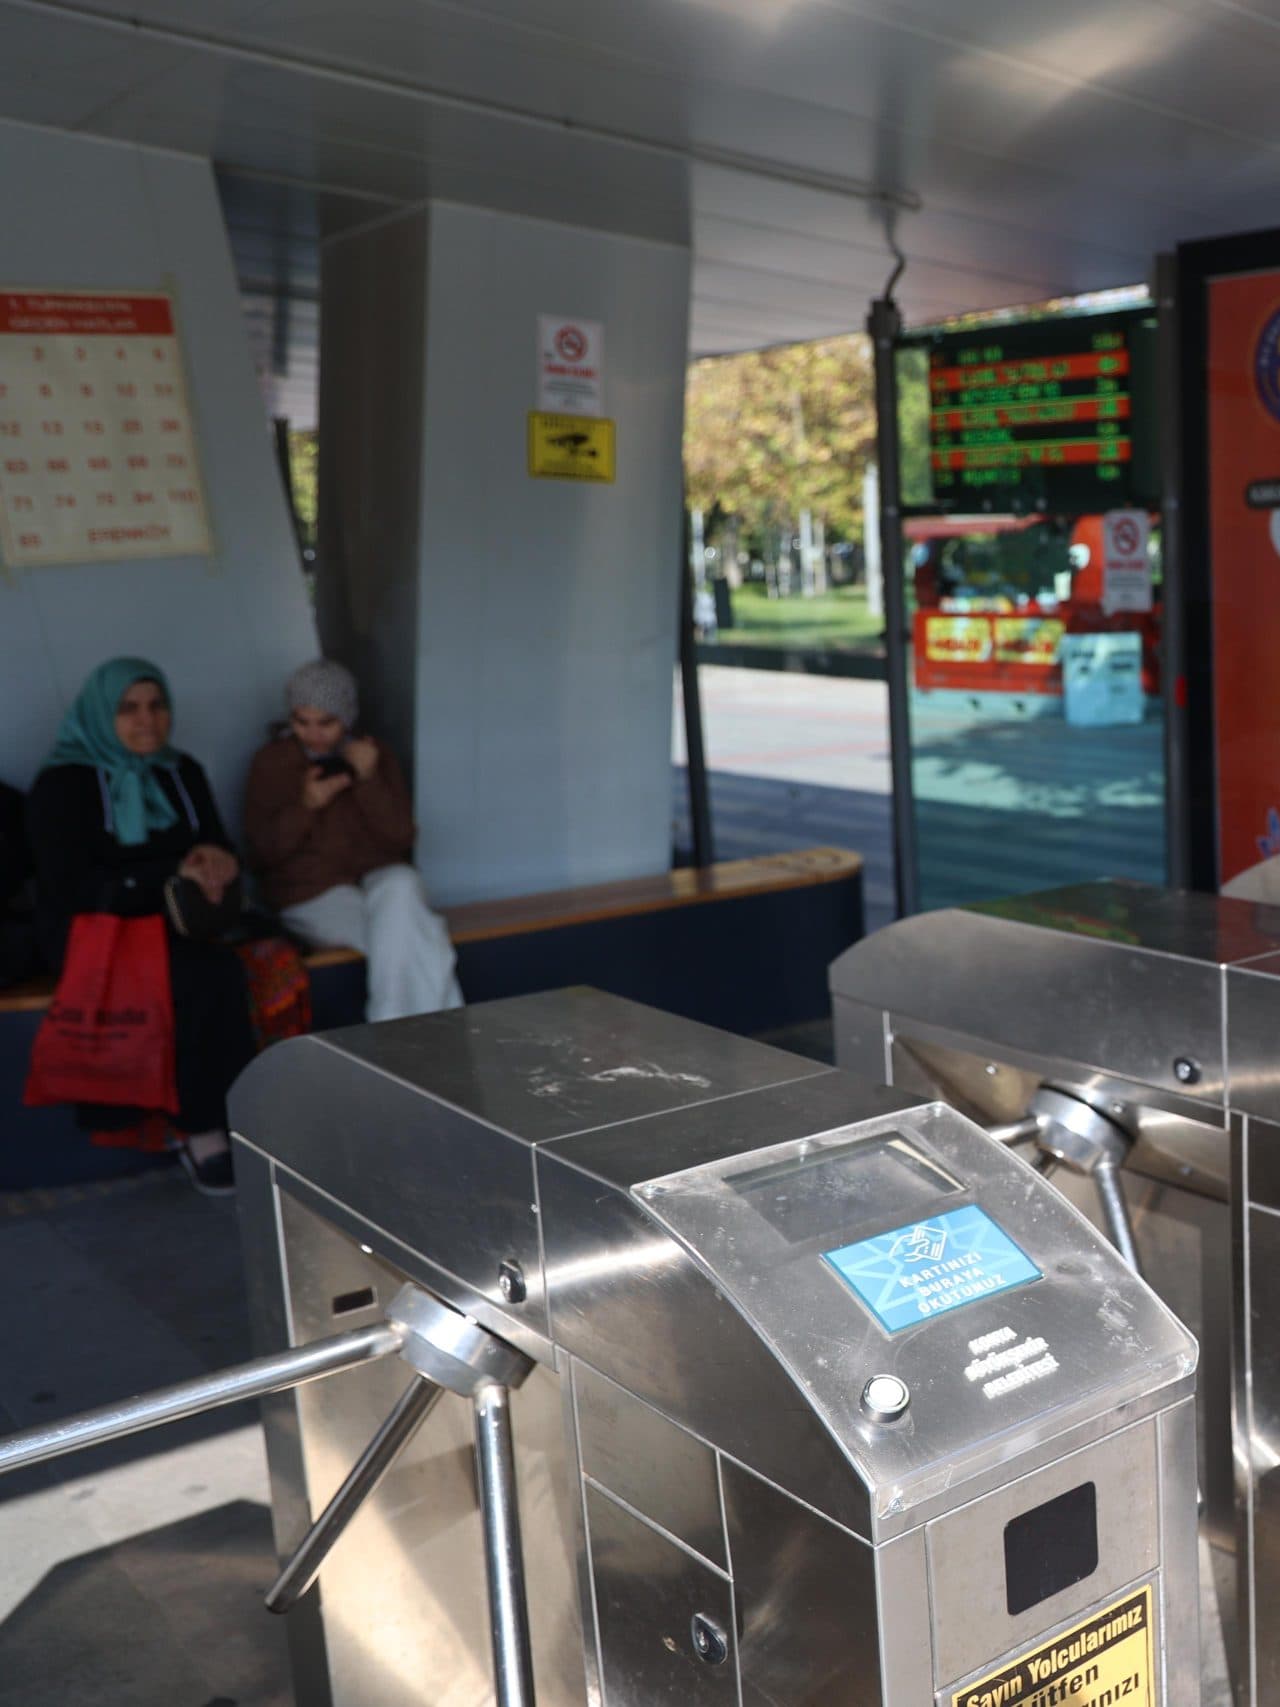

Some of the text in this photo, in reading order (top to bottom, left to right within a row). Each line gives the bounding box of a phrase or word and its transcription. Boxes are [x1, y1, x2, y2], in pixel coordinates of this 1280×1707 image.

[900, 1252, 982, 1288] KARTINIZI
[920, 1268, 985, 1298] BURAYA
[918, 1274, 1007, 1315] OKUTUNUZ
[1027, 1605, 1142, 1686] Yolcularımız
